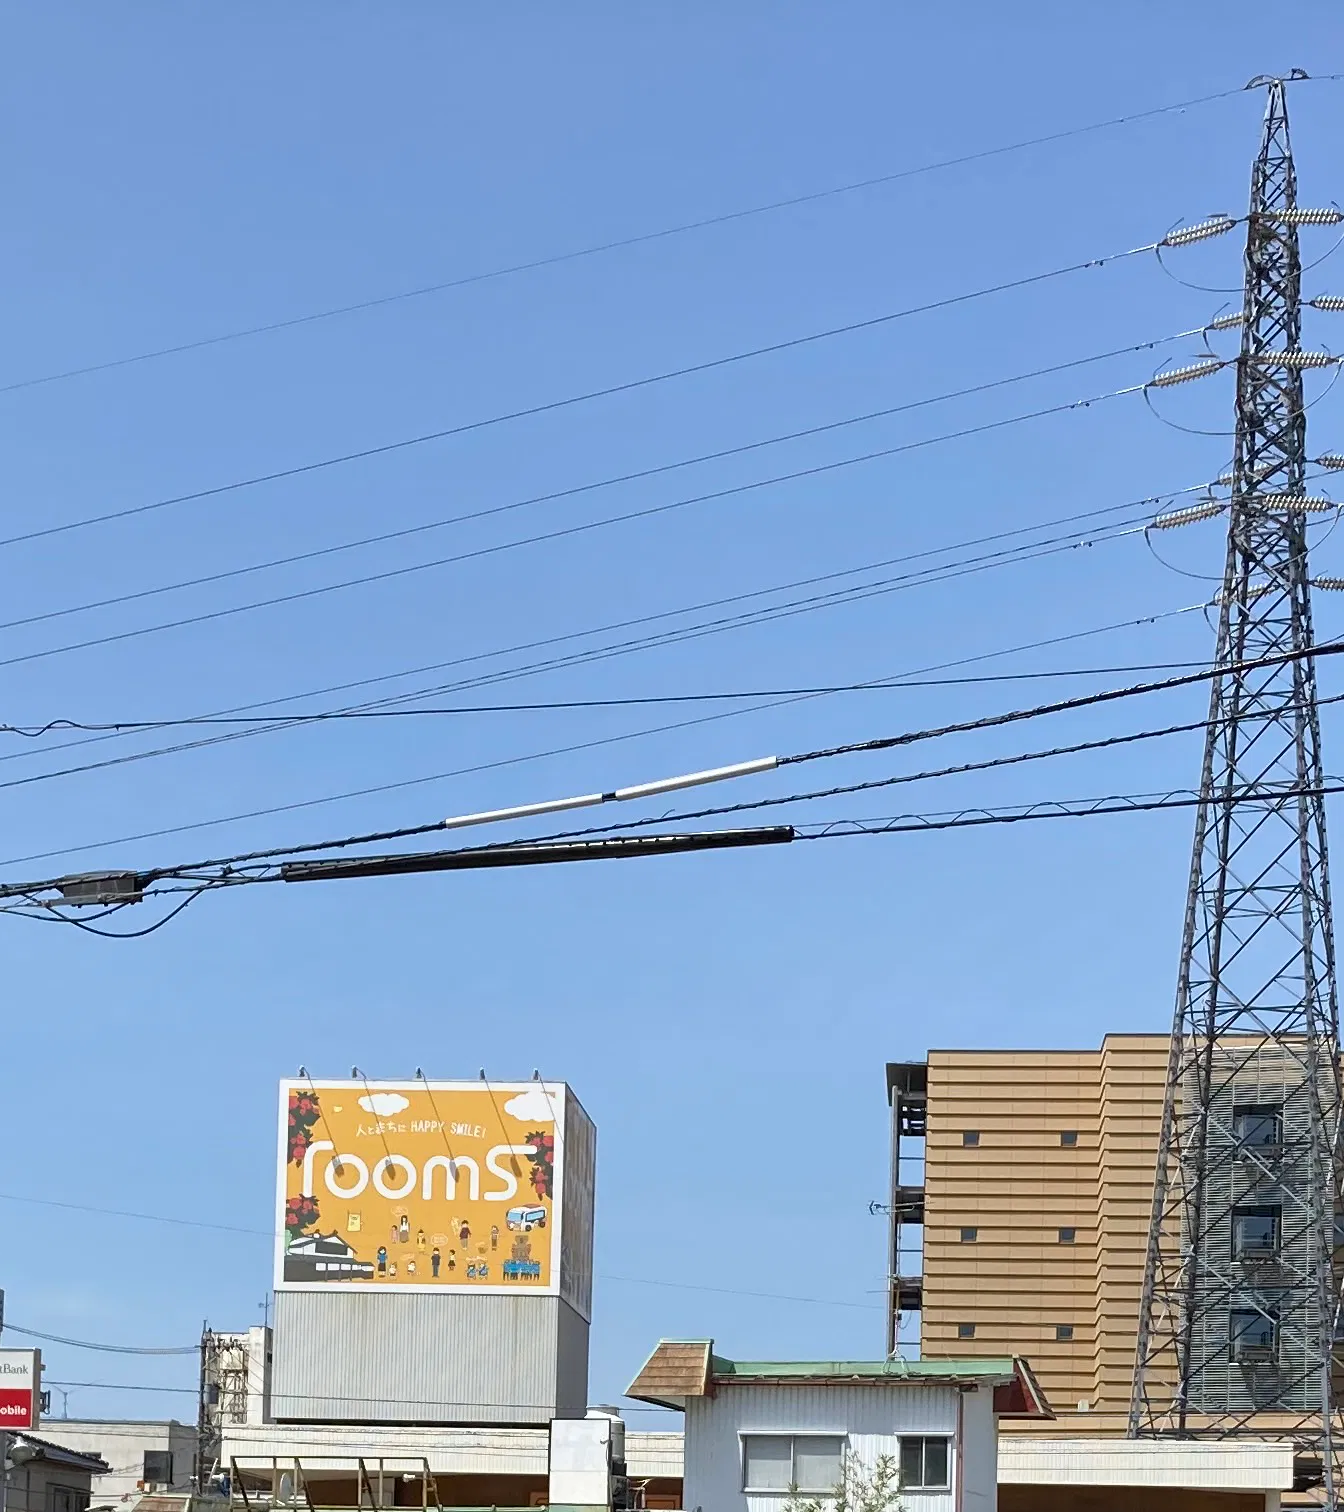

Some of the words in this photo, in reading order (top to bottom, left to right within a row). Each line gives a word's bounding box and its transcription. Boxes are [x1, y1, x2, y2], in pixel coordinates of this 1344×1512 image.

[411, 1121, 445, 1133] HAPPY
[450, 1122, 487, 1139] SMILE!
[302, 1141, 538, 1200] rooms
